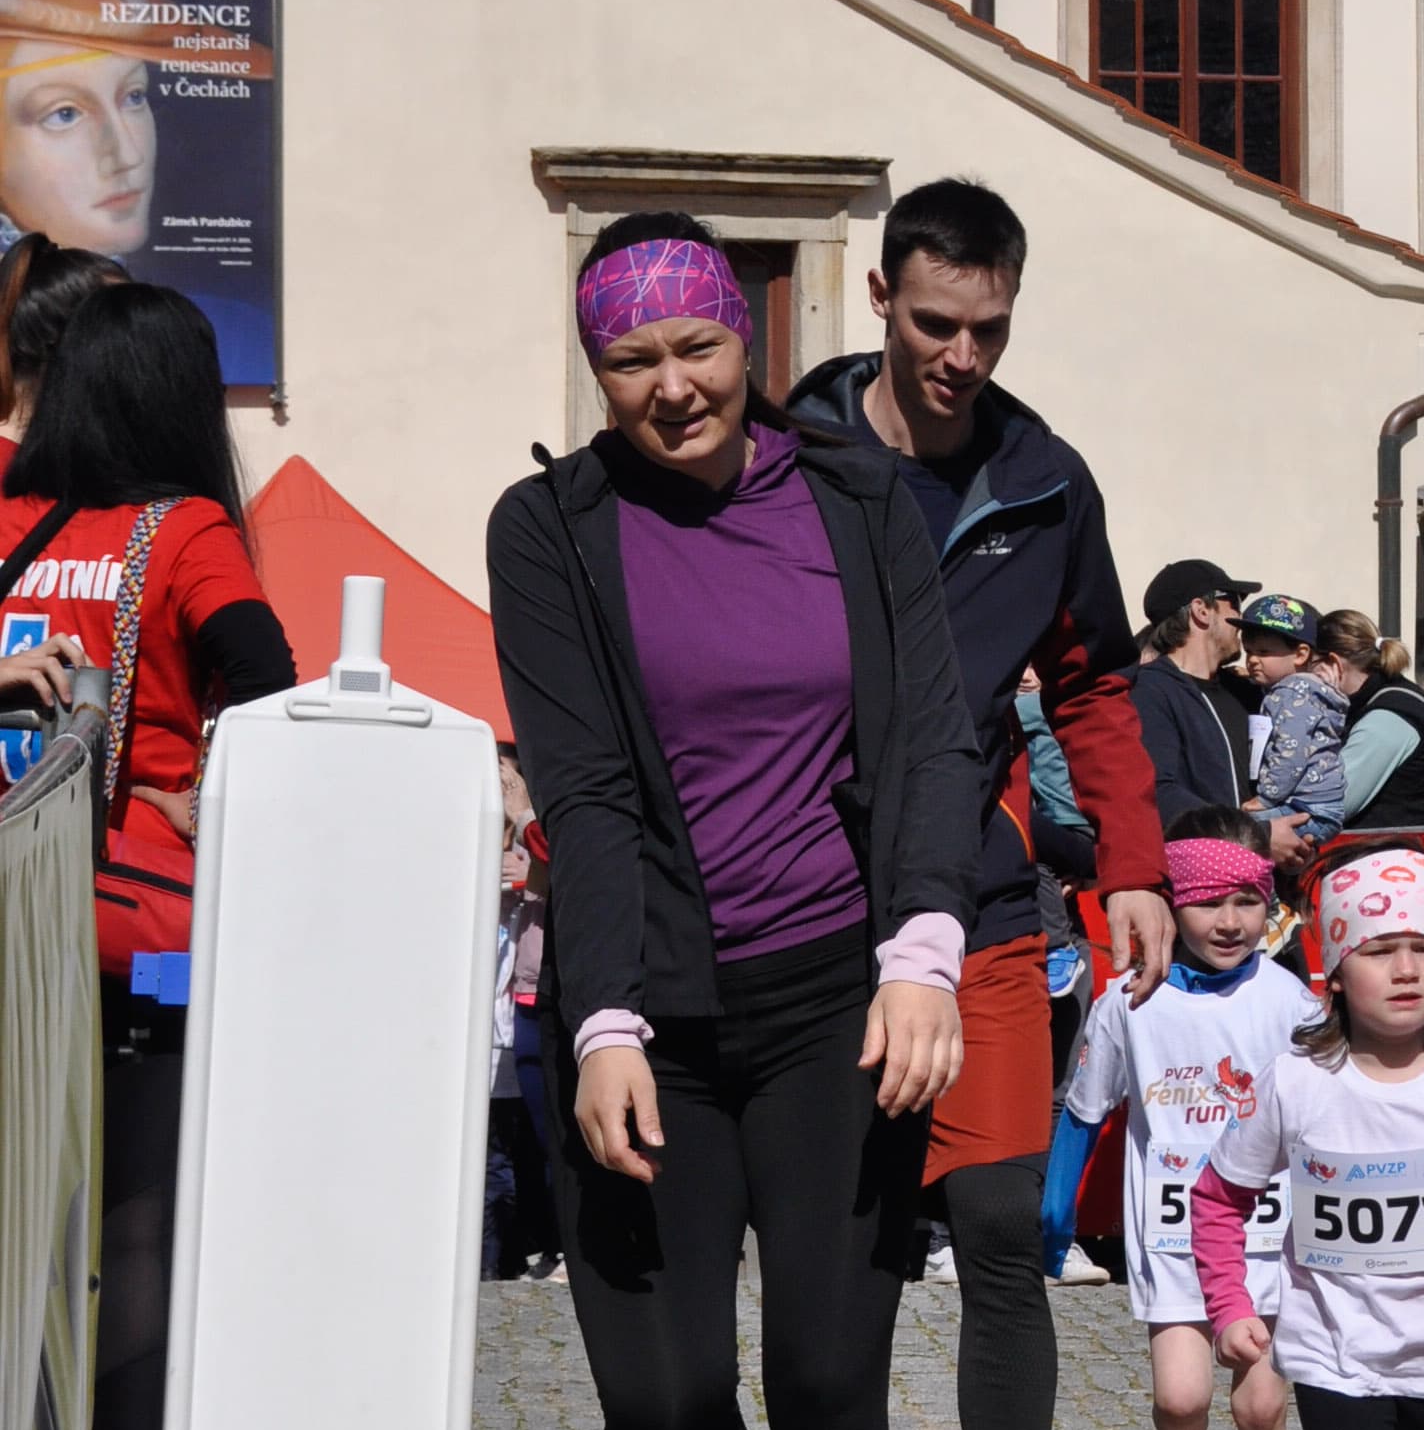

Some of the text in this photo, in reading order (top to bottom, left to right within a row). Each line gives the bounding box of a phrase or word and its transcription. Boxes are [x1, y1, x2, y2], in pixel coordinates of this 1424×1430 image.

[101, 2, 251, 26] REZIDENCE
[174, 33, 250, 52] nejstarší
[161, 60, 250, 75] renesance
[160, 77, 250, 98] v Čechách
[1165, 1066, 1204, 1080] PVZP
[1142, 1080, 1219, 1106] Fénix
[1185, 1105, 1227, 1125] run
[1366, 1161, 1407, 1176] PVZP
[1160, 1182, 1282, 1225] 55
[1317, 1254, 1344, 1266] PVZP
